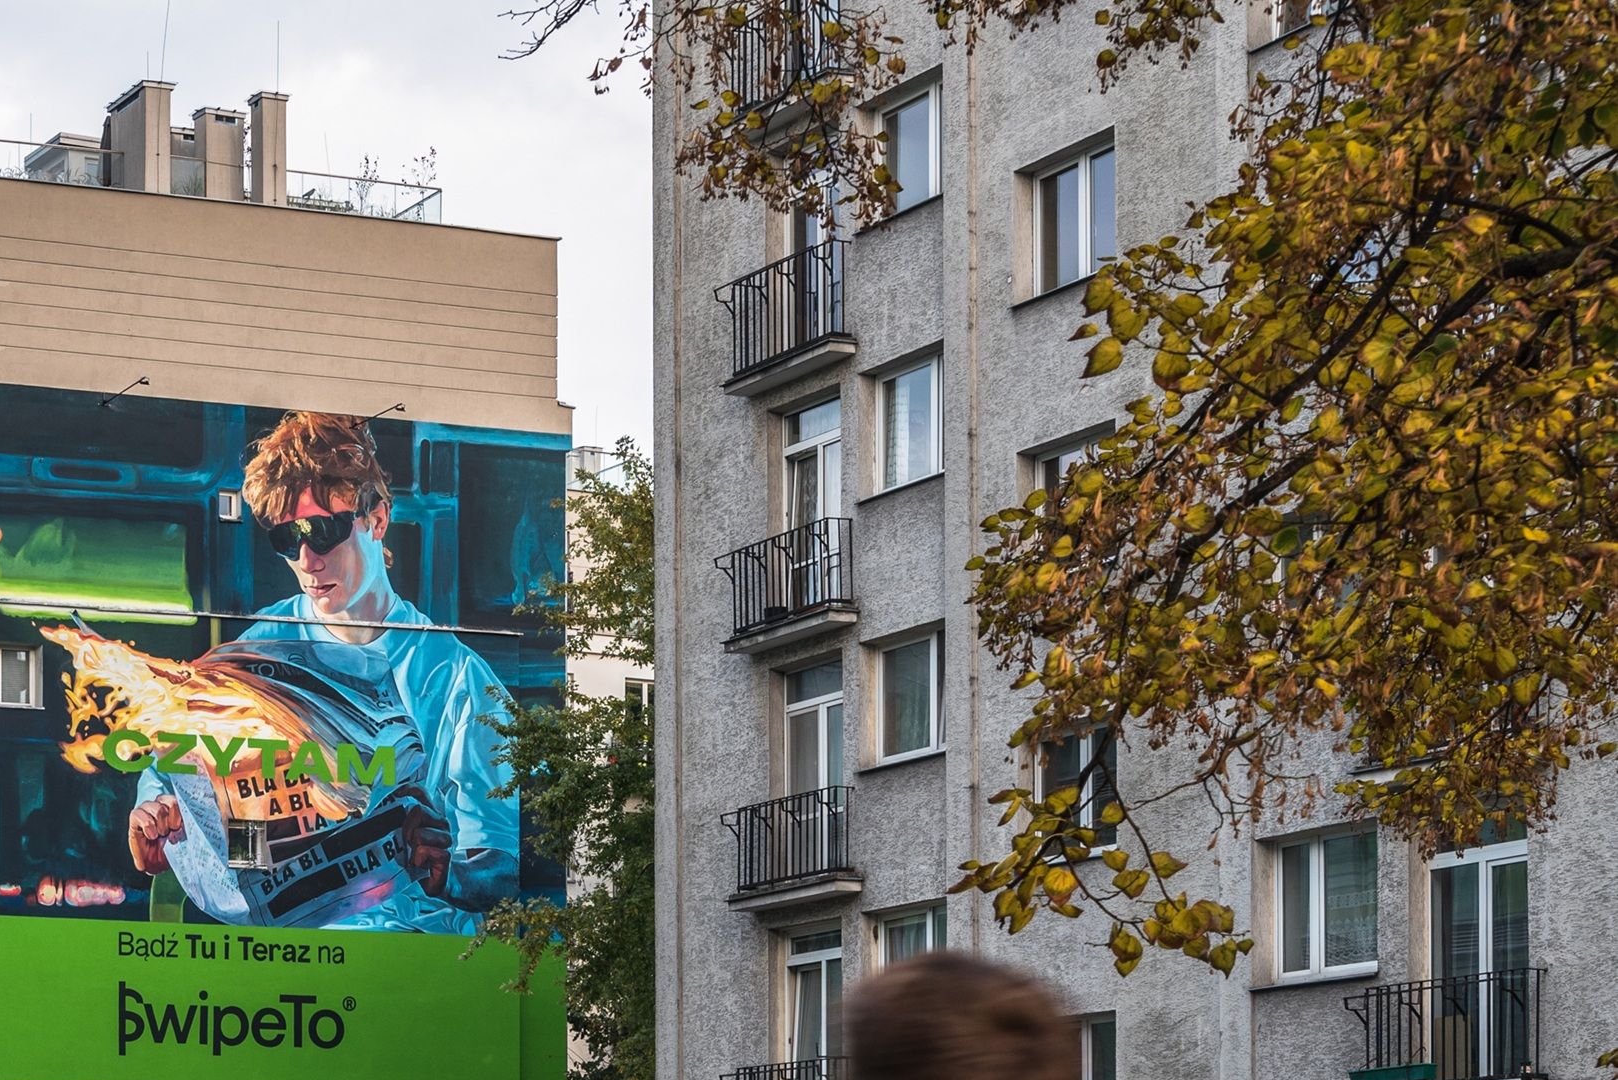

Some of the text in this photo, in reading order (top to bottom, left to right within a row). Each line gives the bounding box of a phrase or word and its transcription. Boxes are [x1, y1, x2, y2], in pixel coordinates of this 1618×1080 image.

[103, 730, 396, 786] CZYTAM
[237, 776, 278, 799] BLA
[342, 850, 381, 879] BLA
[118, 932, 345, 965] Bądź Tu i Teraz na
